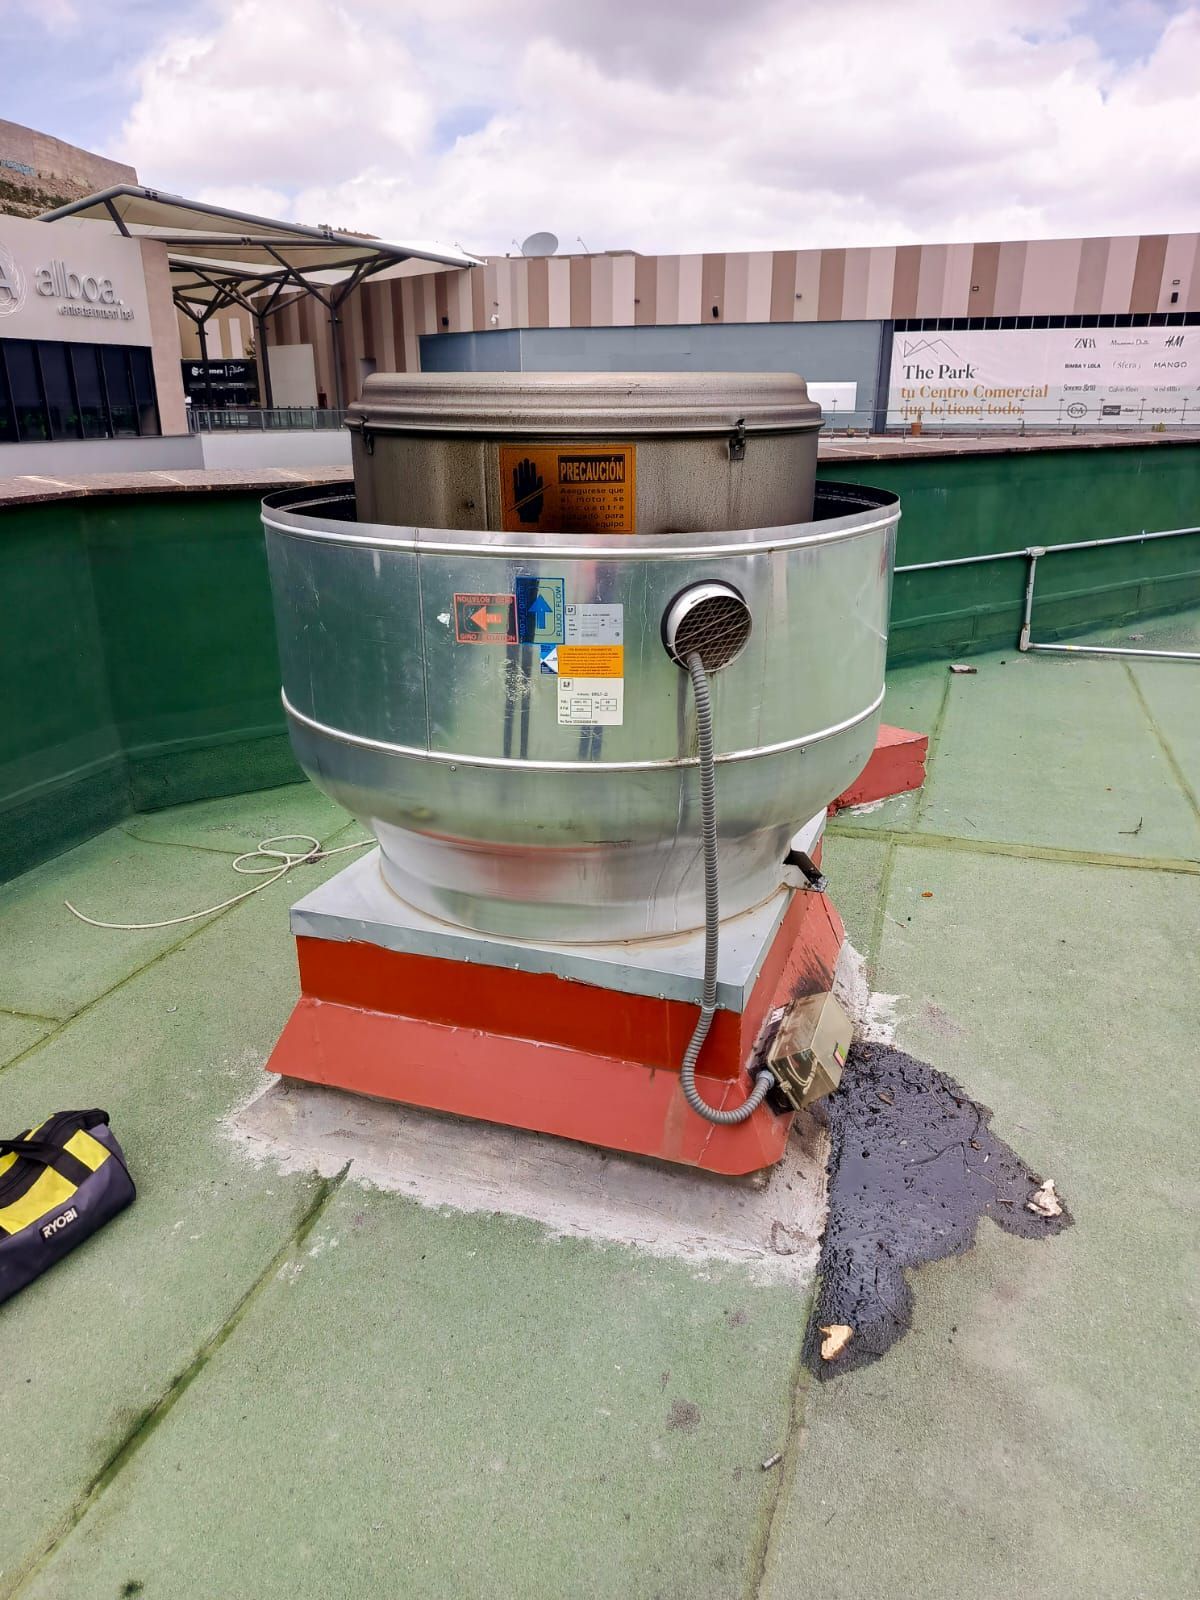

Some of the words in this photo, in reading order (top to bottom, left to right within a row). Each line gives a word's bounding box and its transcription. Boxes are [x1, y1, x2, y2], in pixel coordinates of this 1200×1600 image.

[1165, 335, 1185, 348] H&M
[902, 364, 934, 380] The
[938, 363, 976, 380] Park
[1153, 361, 1188, 369] MANGO
[900, 387, 915, 399] tu
[919, 384, 969, 399] Centro
[973, 383, 1049, 399] Comercial
[900, 404, 926, 417] que
[930, 401, 943, 415] lo
[947, 402, 982, 415] tiene
[560, 457, 623, 481] PRECAUCIÓN
[608, 487, 624, 495] que
[605, 513, 625, 521] para
[41, 1207, 78, 1239] RYOBI
